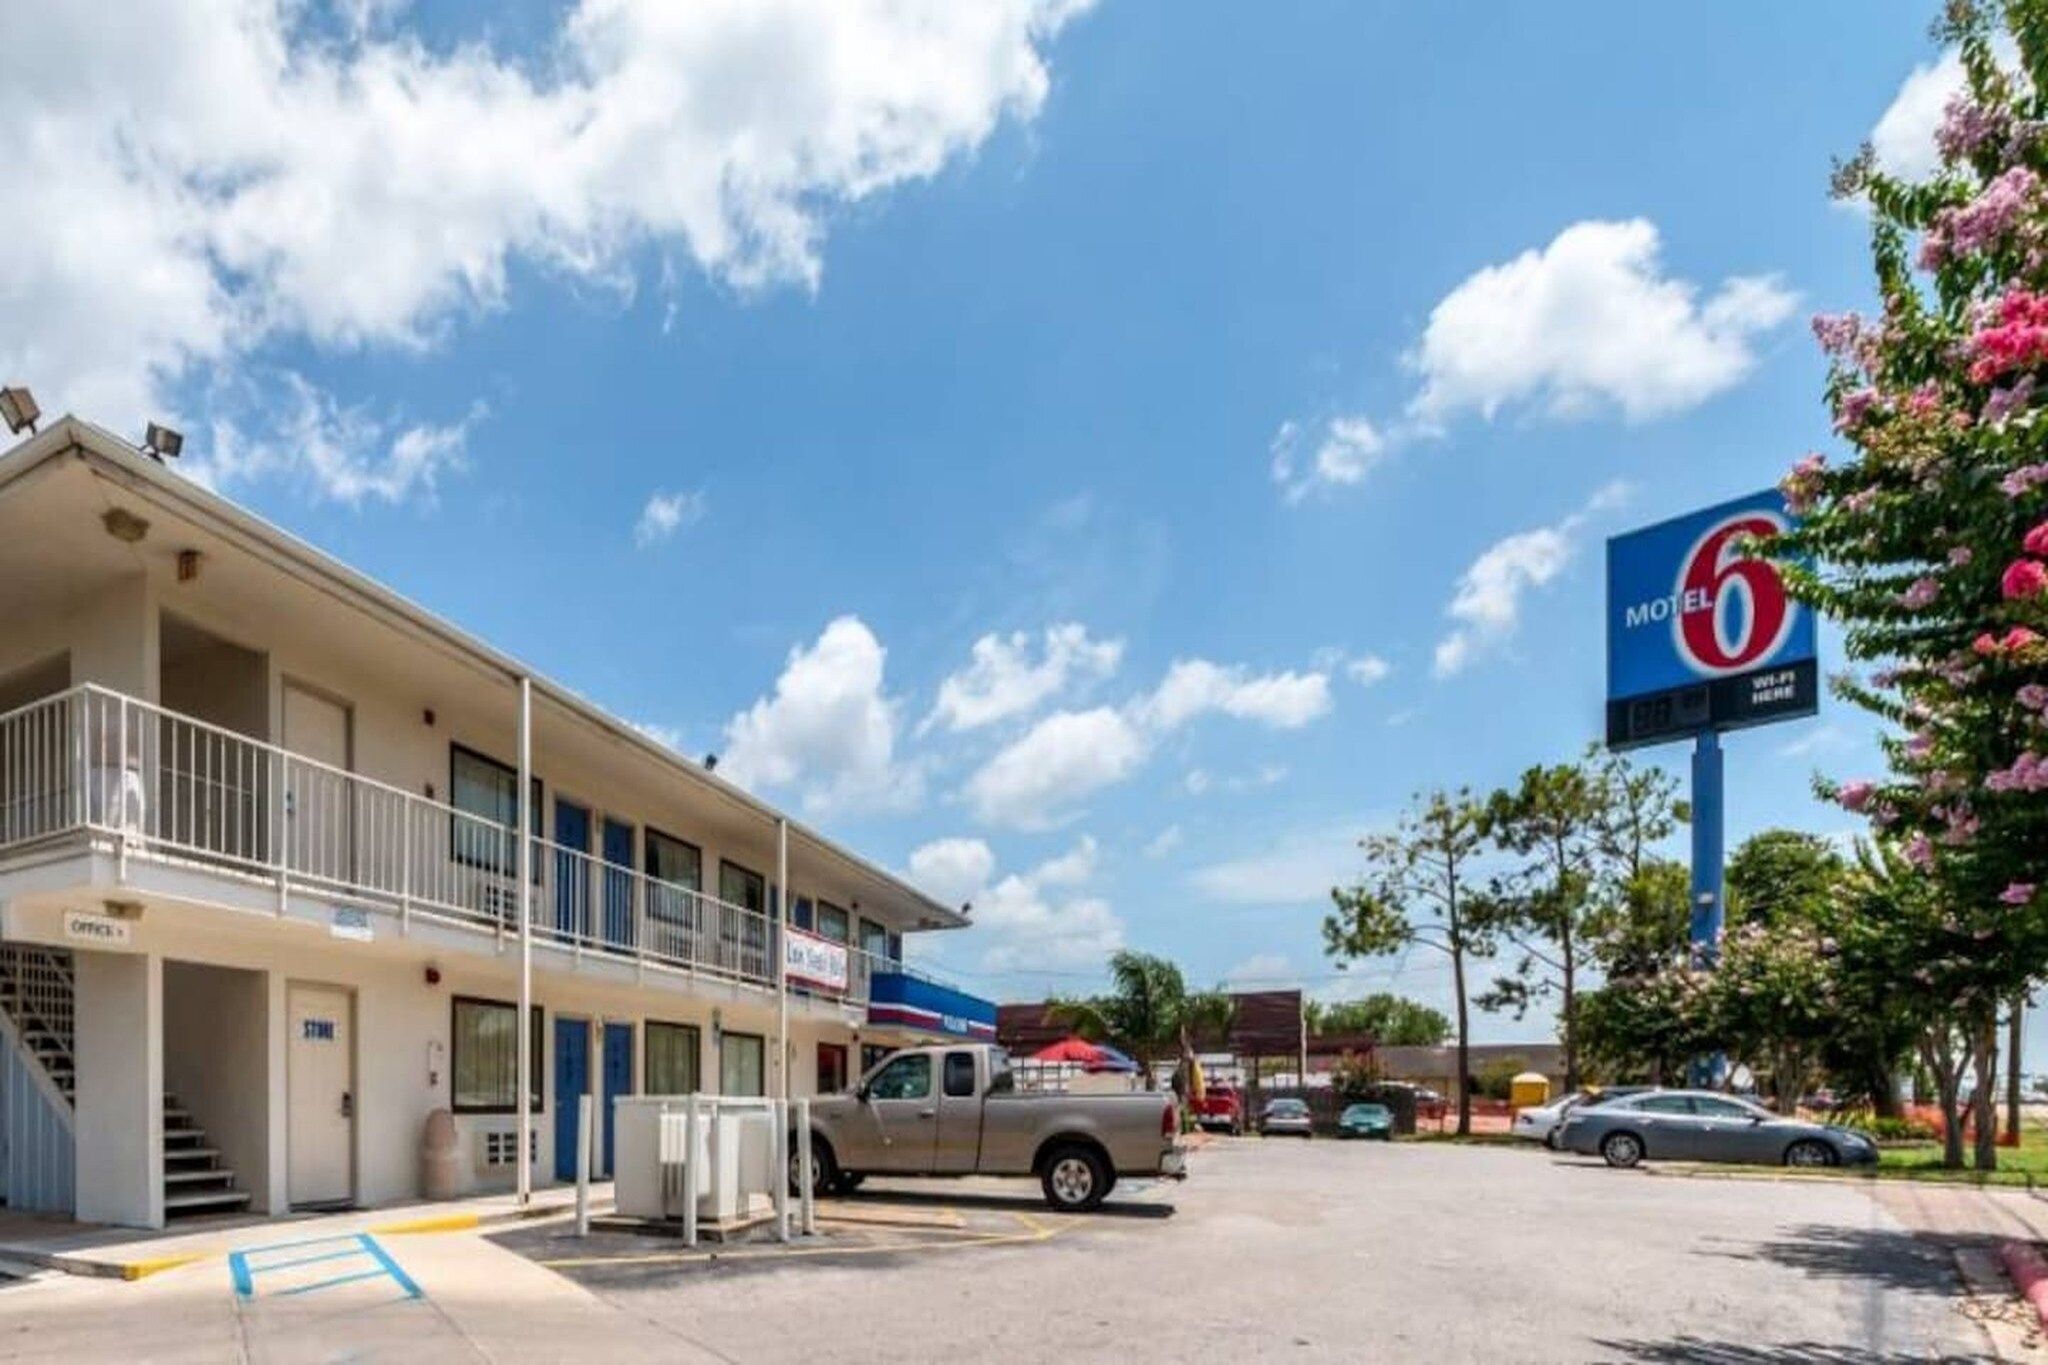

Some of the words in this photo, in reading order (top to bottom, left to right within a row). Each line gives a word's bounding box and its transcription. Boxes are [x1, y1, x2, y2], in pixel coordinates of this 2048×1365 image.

[1626, 587, 1714, 628] MOTEL
[1675, 512, 1794, 675] 6
[1753, 670, 1796, 689] WI-FI
[1752, 685, 1795, 704] HERE
[71, 919, 114, 937] OFFICE
